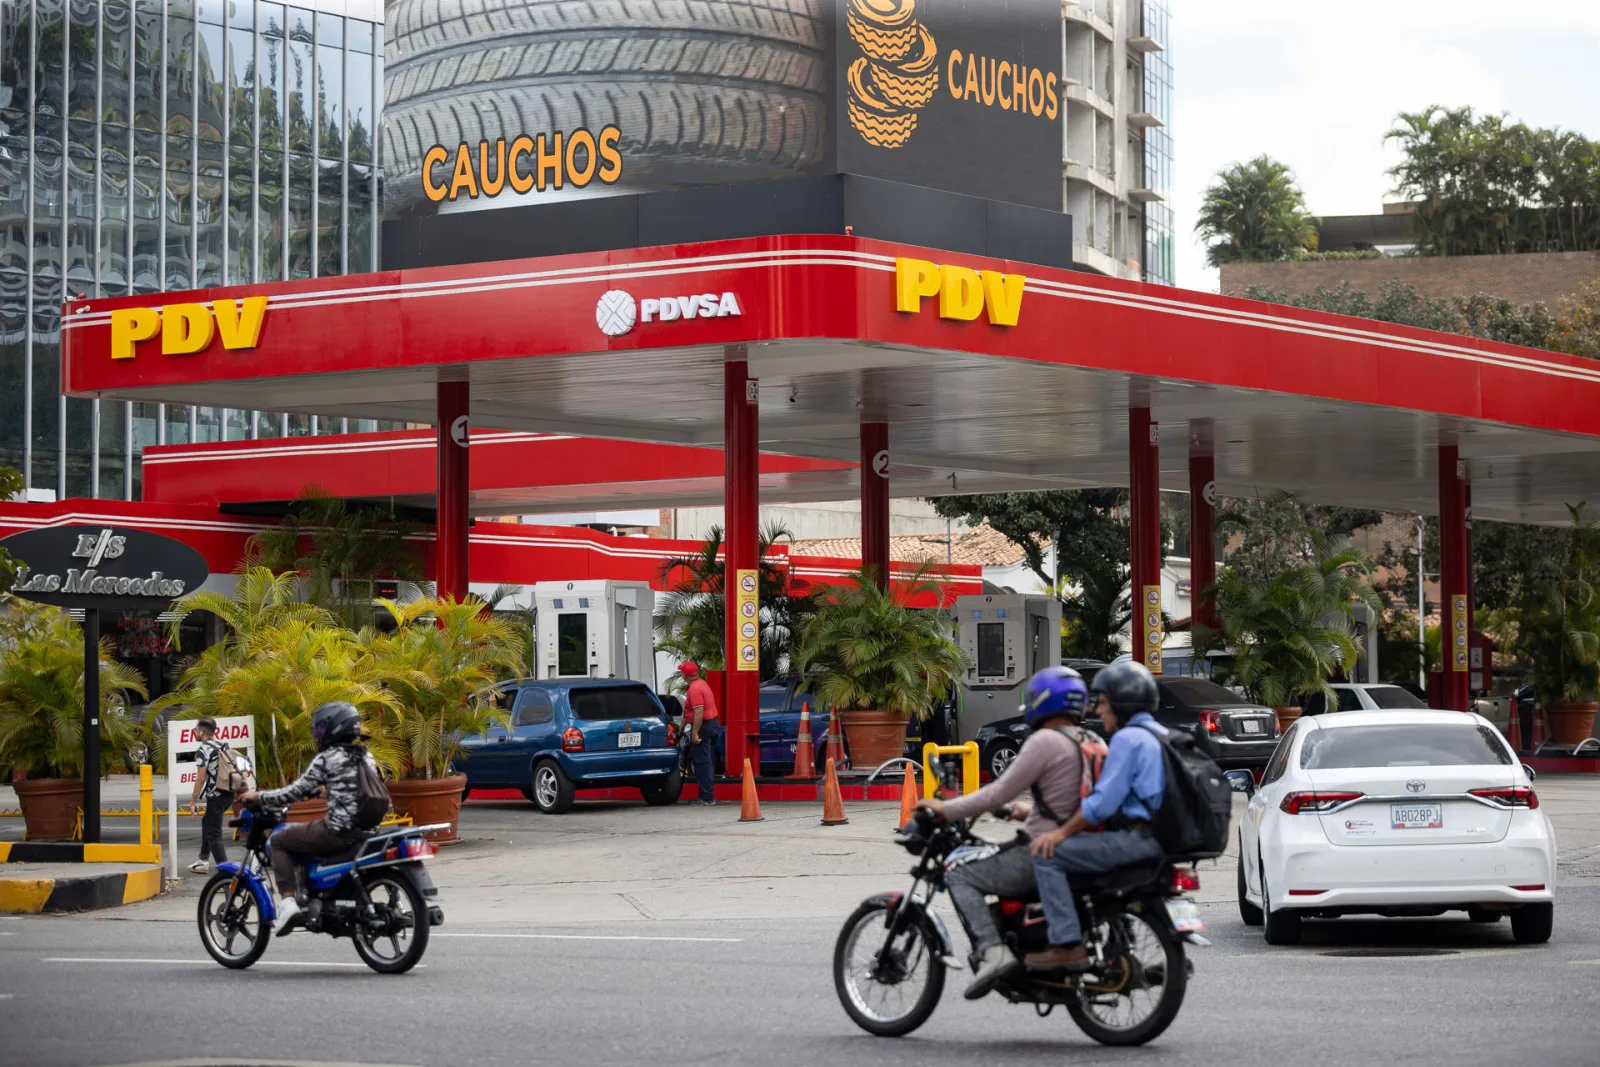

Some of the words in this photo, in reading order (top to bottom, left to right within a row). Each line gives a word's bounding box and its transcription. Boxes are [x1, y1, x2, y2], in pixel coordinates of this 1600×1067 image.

[948, 49, 1058, 120] CAUCHOS
[422, 125, 623, 202] CAUCHOS
[641, 292, 741, 322] PDVSA
[895, 257, 1026, 327] PDV
[111, 296, 269, 359] PDV
[457, 420, 469, 443] 1
[879, 454, 889, 474] 2
[72, 529, 127, 567] E/S
[11, 566, 62, 593] Las
[61, 568, 186, 597] Mercedes
[180, 725, 249, 743] ENRADA
[1395, 809, 1438, 822] AB028PJ
